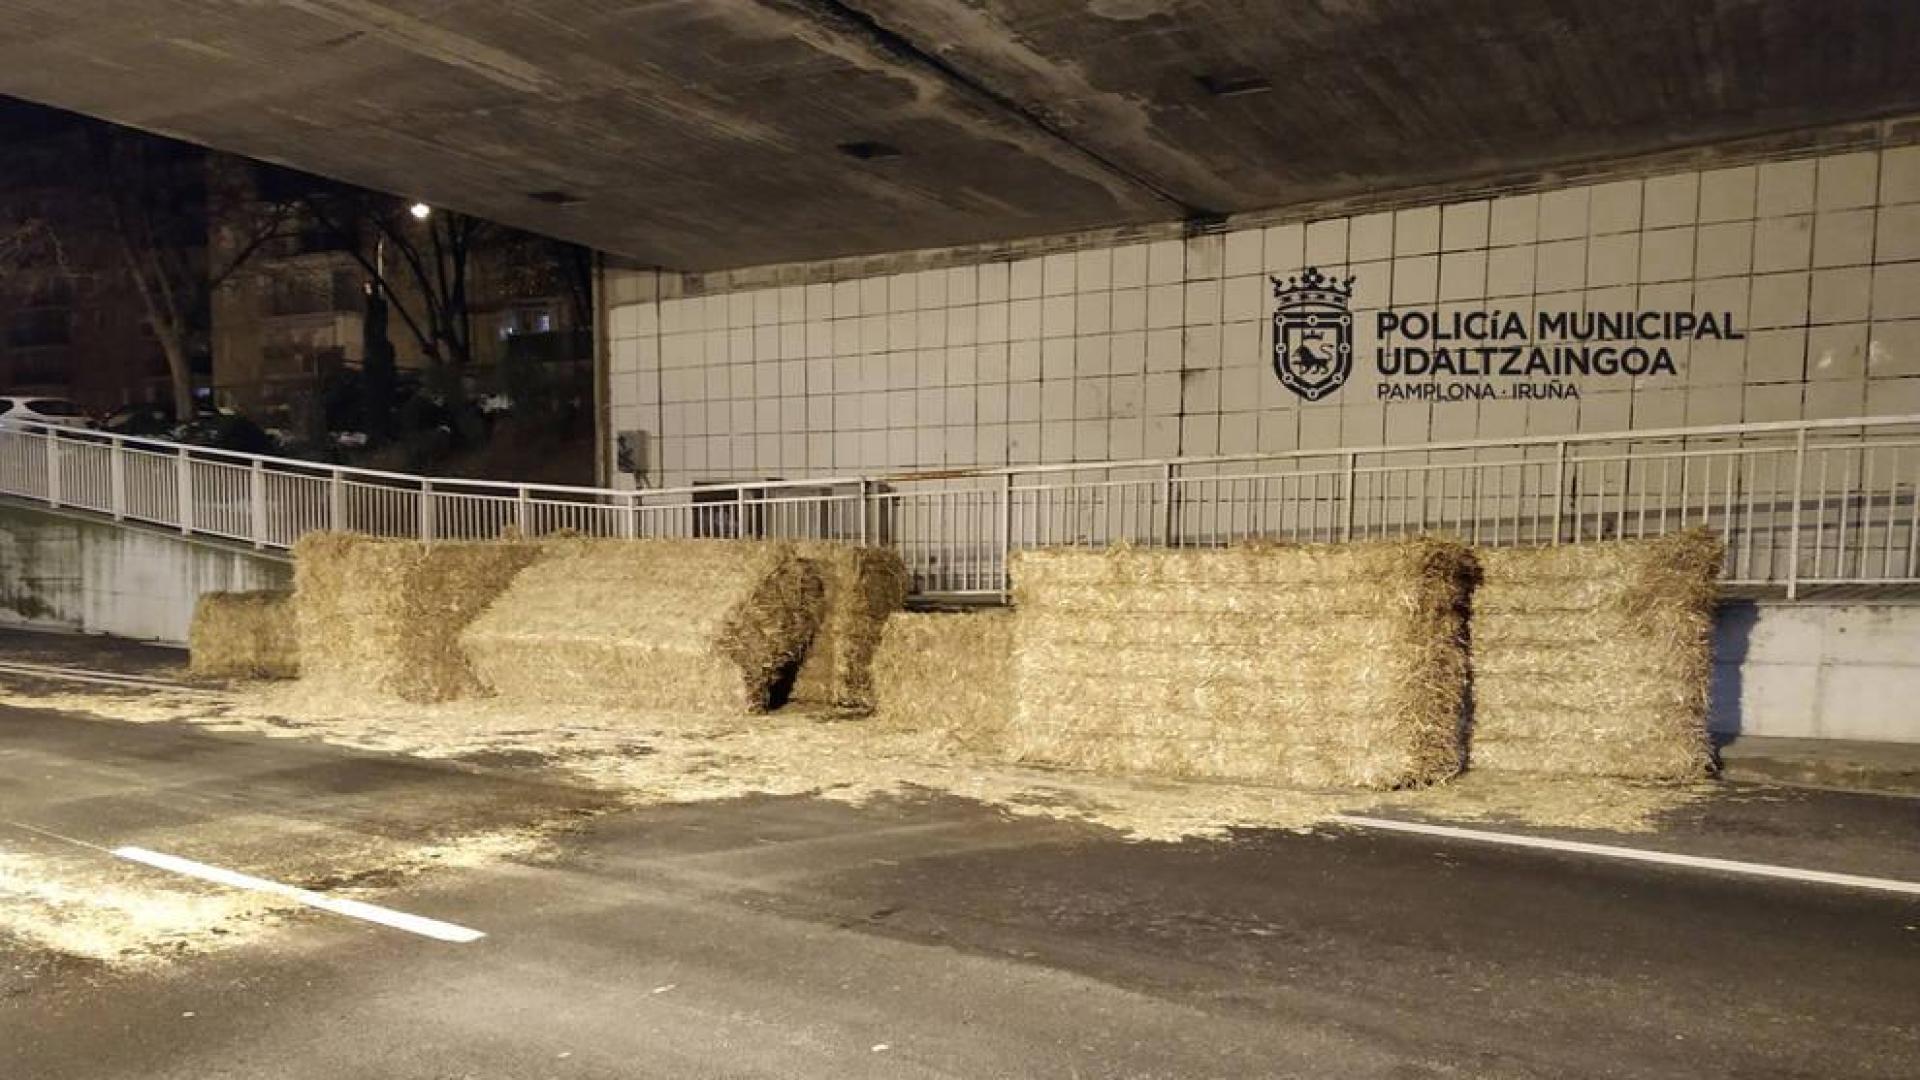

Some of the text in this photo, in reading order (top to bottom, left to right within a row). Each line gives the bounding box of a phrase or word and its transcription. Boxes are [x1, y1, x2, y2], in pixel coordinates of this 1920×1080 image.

[1539, 311, 1745, 340] MUNICIPAL
[1376, 346, 1677, 375] UDALTZAINGOA
[1377, 383, 1497, 399] PAMPLONA
[1512, 379, 1580, 400] IRUÑA
